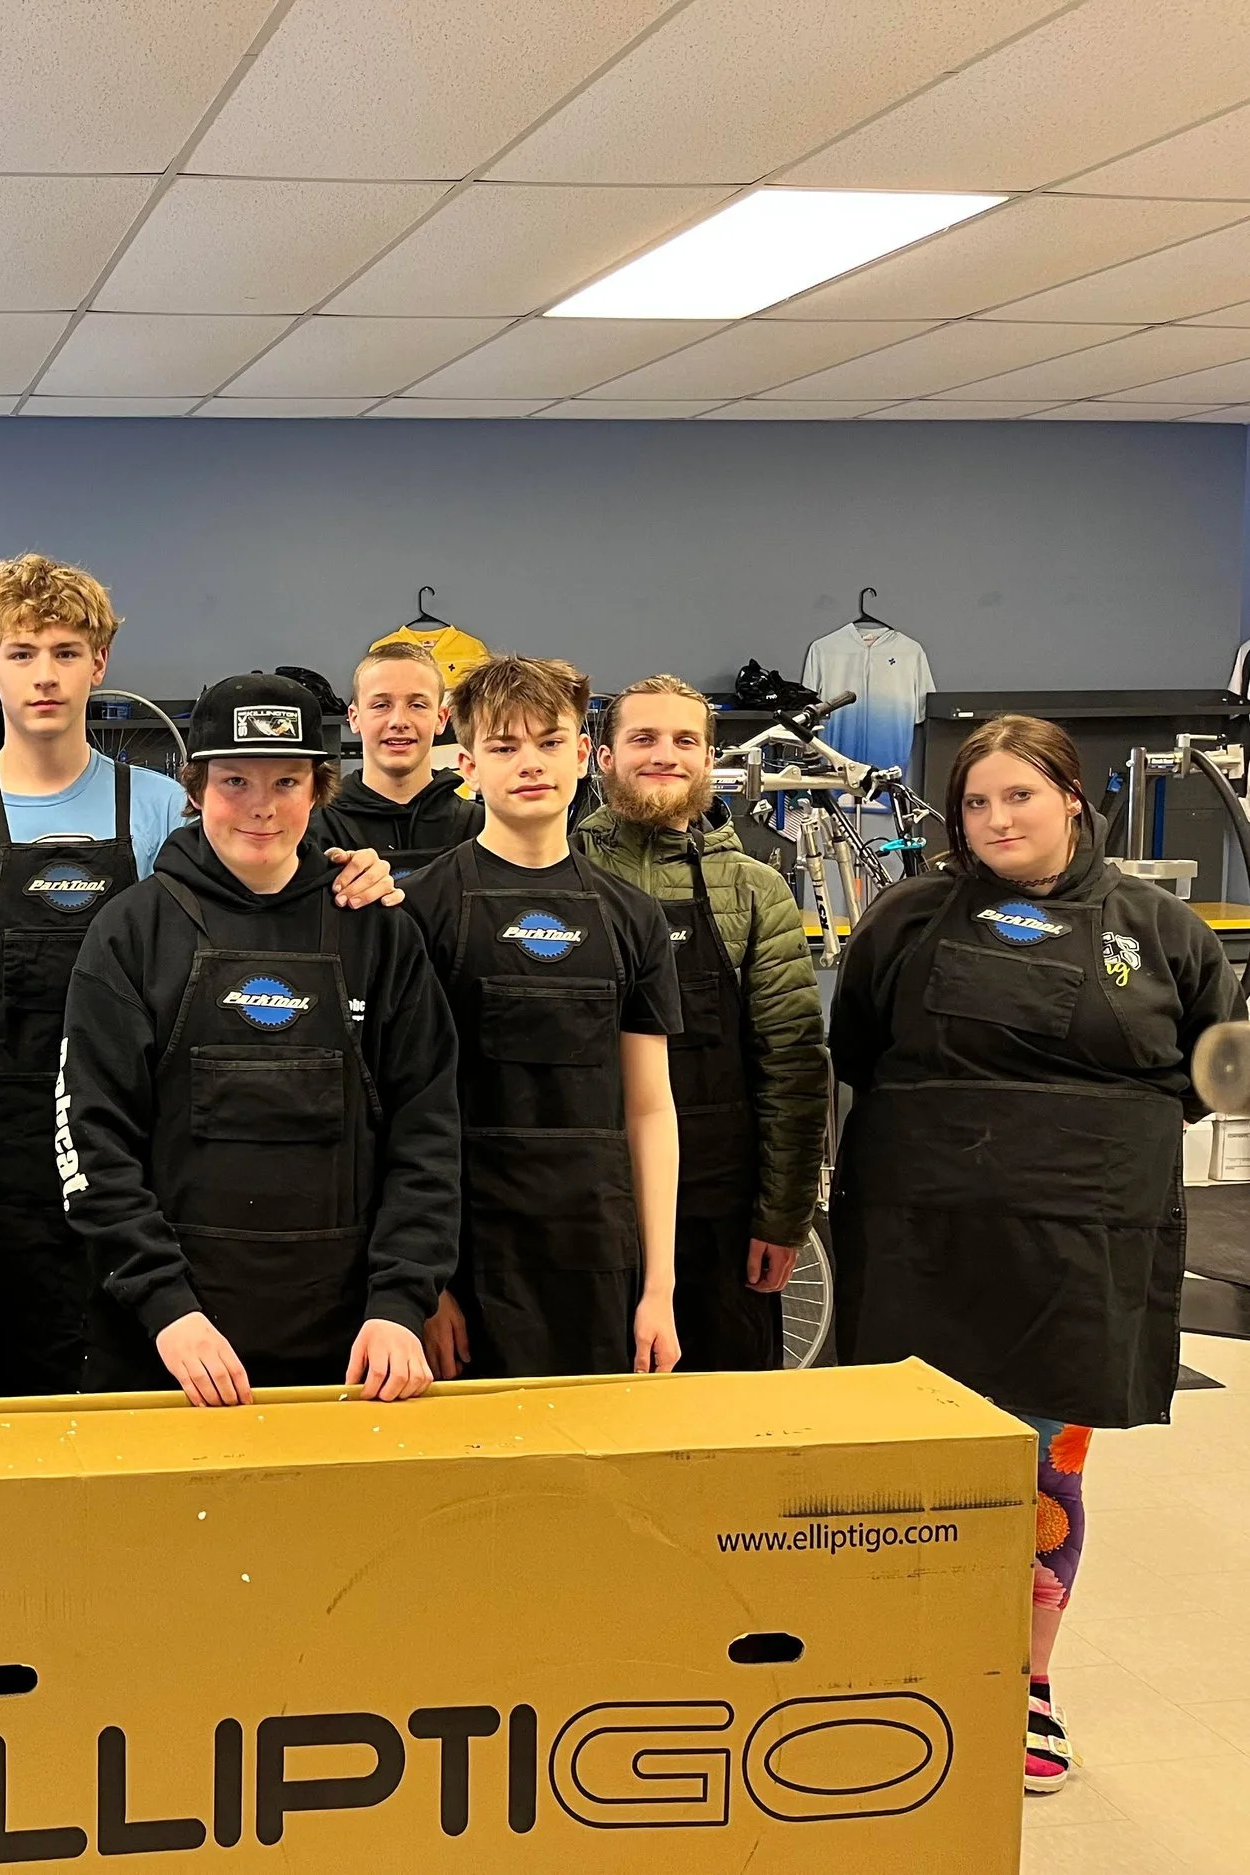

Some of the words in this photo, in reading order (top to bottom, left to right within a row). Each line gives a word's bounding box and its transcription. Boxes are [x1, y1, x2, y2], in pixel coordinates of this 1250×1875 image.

[238, 711, 248, 737] SKI
[247, 710, 298, 718] KILLINGTON
[716, 1519, 959, 1556] www.elliptigo.com
